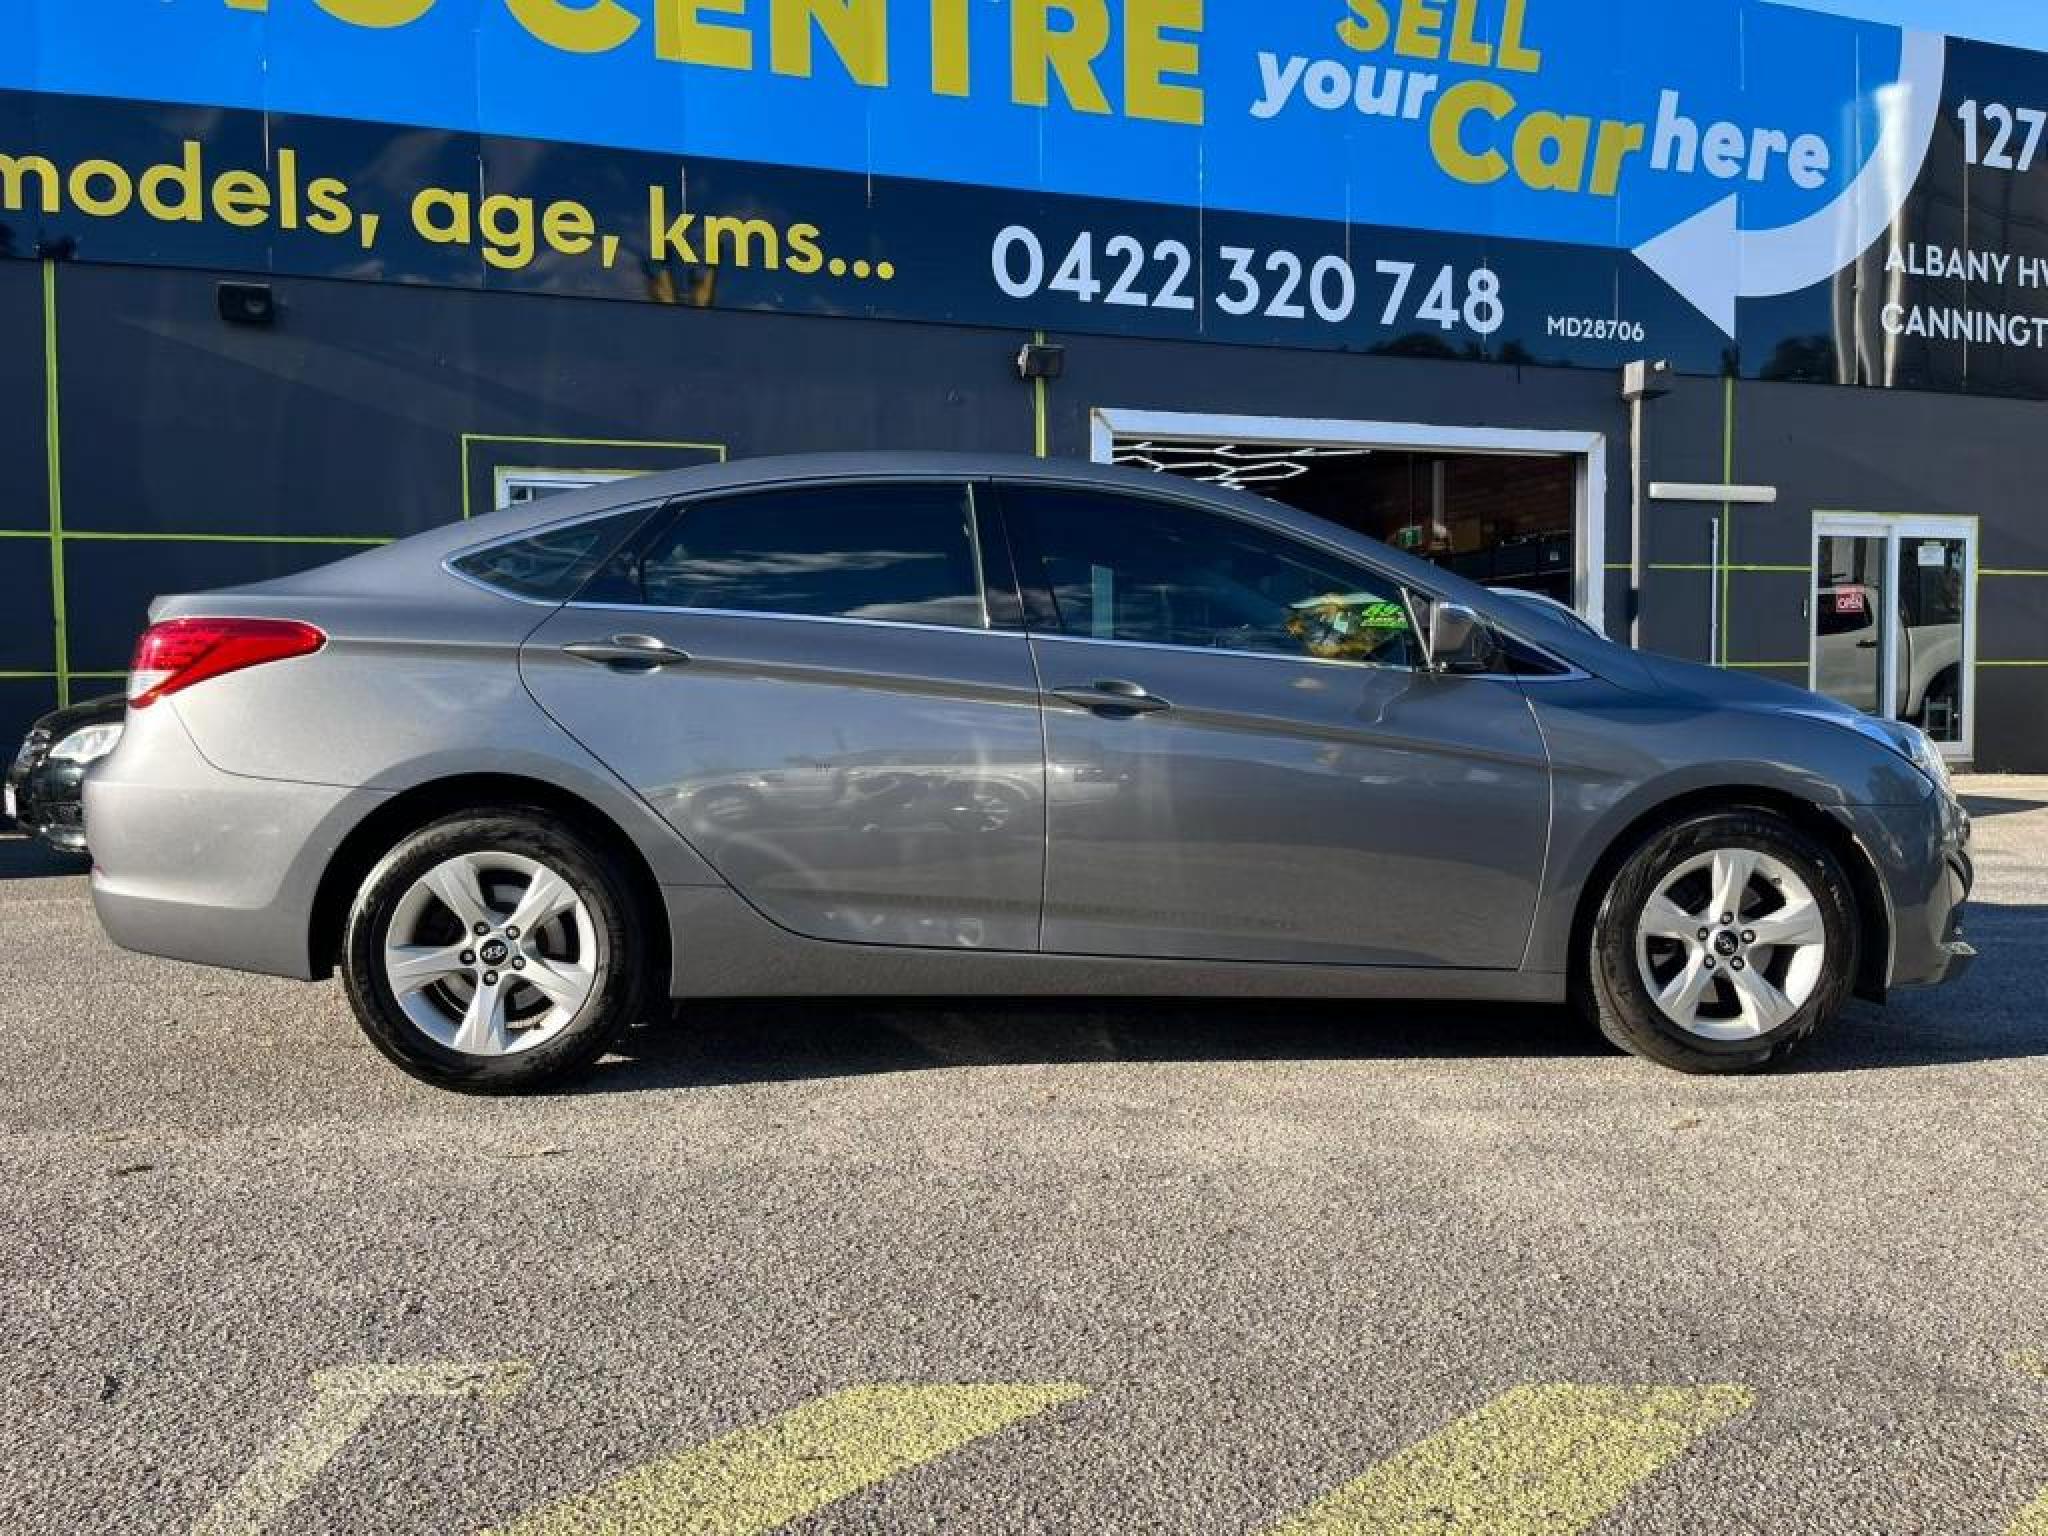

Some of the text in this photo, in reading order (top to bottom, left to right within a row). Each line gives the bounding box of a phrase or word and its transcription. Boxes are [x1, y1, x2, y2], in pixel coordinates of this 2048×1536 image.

[1337, 0, 1541, 72] SELL
[1250, 51, 1831, 196] your Car here
[1956, 99, 2048, 171] 127
[0, 140, 895, 280] models, age, kms...
[991, 225, 1504, 335] 0422 320 748
[1884, 242, 2011, 286] ALBANY
[1547, 315, 1645, 342] MD28706
[1881, 302, 2048, 349] CANNINGT
